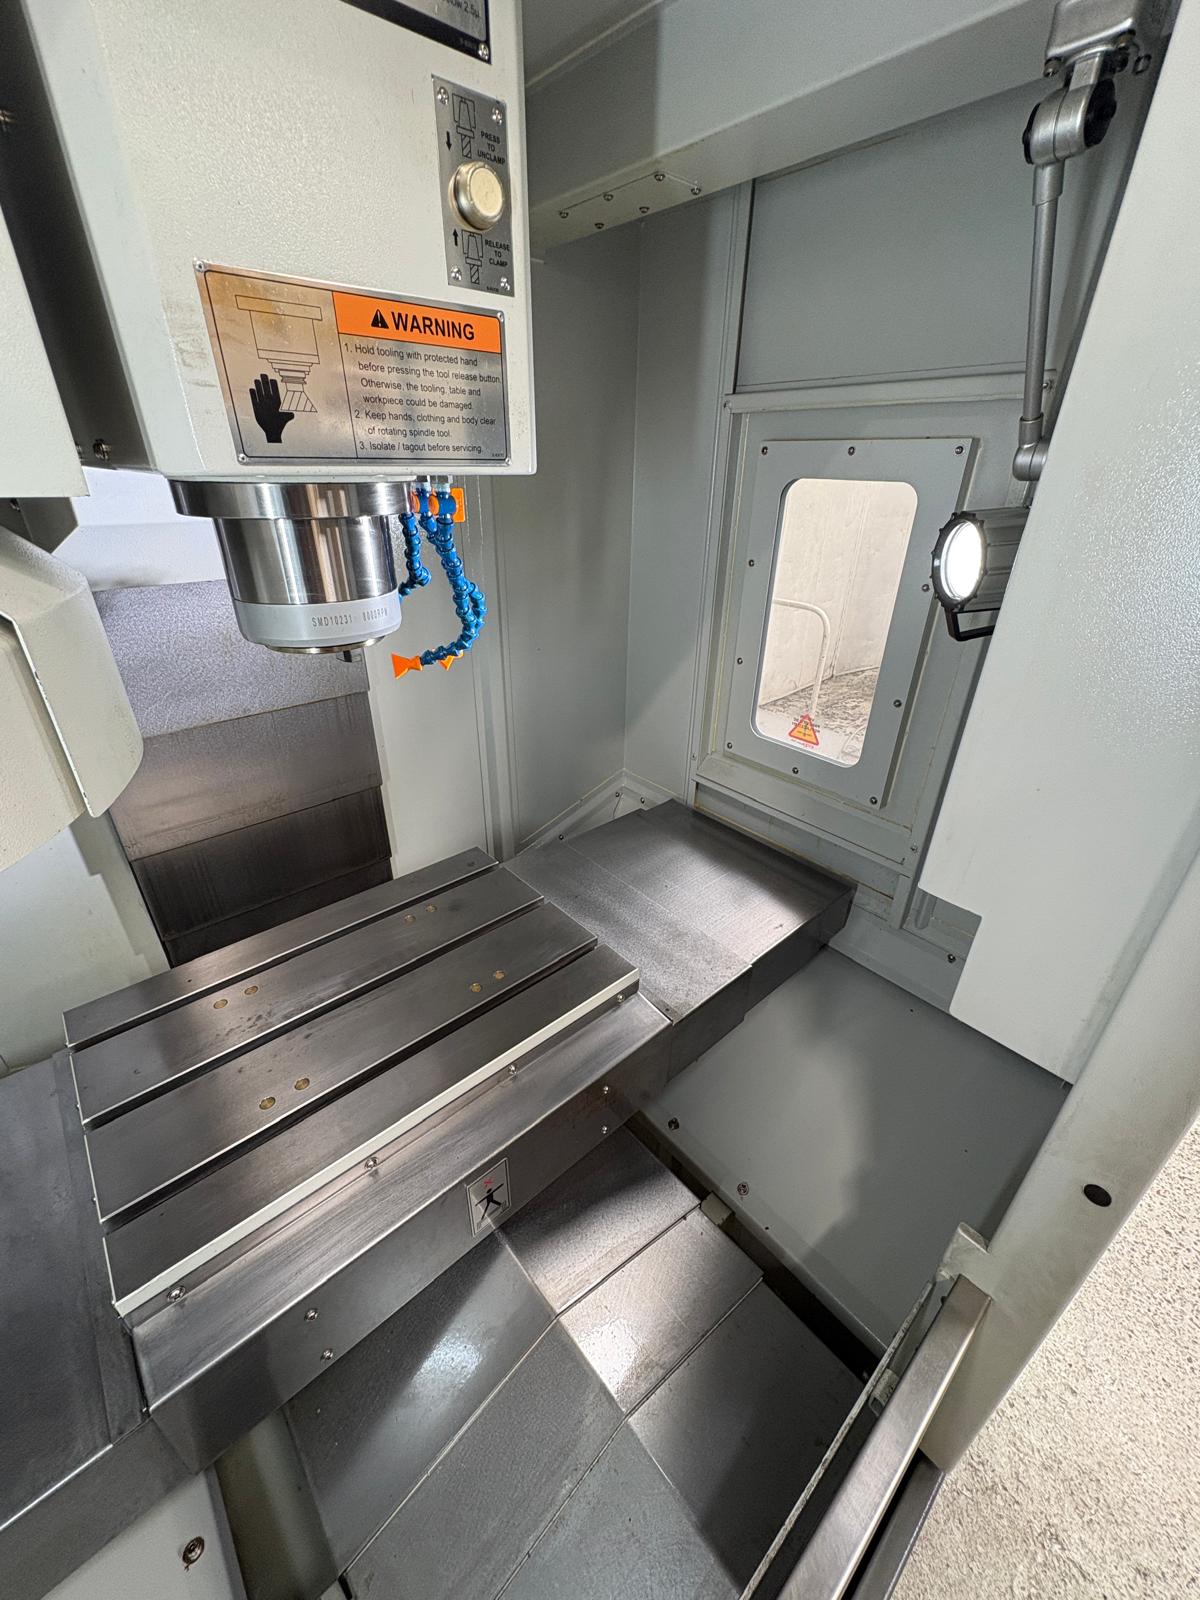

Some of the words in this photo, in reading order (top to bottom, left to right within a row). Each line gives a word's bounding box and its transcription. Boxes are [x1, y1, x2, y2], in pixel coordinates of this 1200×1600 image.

[480, 130, 500, 144] PRESS
[487, 142, 496, 152] TO
[477, 149, 506, 165] UNCLAMP
[485, 239, 510, 251] RELEASE
[494, 250, 502, 258] TO
[489, 258, 508, 267] CLAMP
[391, 311, 475, 341] WARNING
[344, 343, 353, 353] 1.
[354, 343, 375, 355] Hold
[376, 347, 404, 361] tooling
[406, 351, 422, 360] with
[424, 353, 458, 364] protected
[460, 357, 478, 367] hand
[357, 361, 385, 372] before
[387, 366, 421, 378] pressing
[422, 368, 435, 376] the
[436, 370, 450, 379] tool
[451, 372, 478, 382] release
[360, 377, 405, 391] Otherwise,
[406, 381, 419, 391] the
[449, 386, 467, 396] table
[468, 388, 481, 397] and
[362, 395, 404, 406] workpiece
[405, 399, 427, 407] could
[428, 400, 438, 408] be
[364, 409, 387, 422] Keep
[388, 411, 415, 422] hands,
[416, 413, 446, 425] clothing
[446, 416, 460, 424] and
[461, 416, 479, 427] body
[480, 416, 497, 426] clear
[367, 426, 376, 435] of
[377, 427, 408, 439] rotating
[408, 428, 436, 439] spindle
[359, 441, 369, 451] 3.
[369, 441, 396, 451] Isolate
[402, 443, 426, 454] tagout
[427, 443, 451, 452] before
